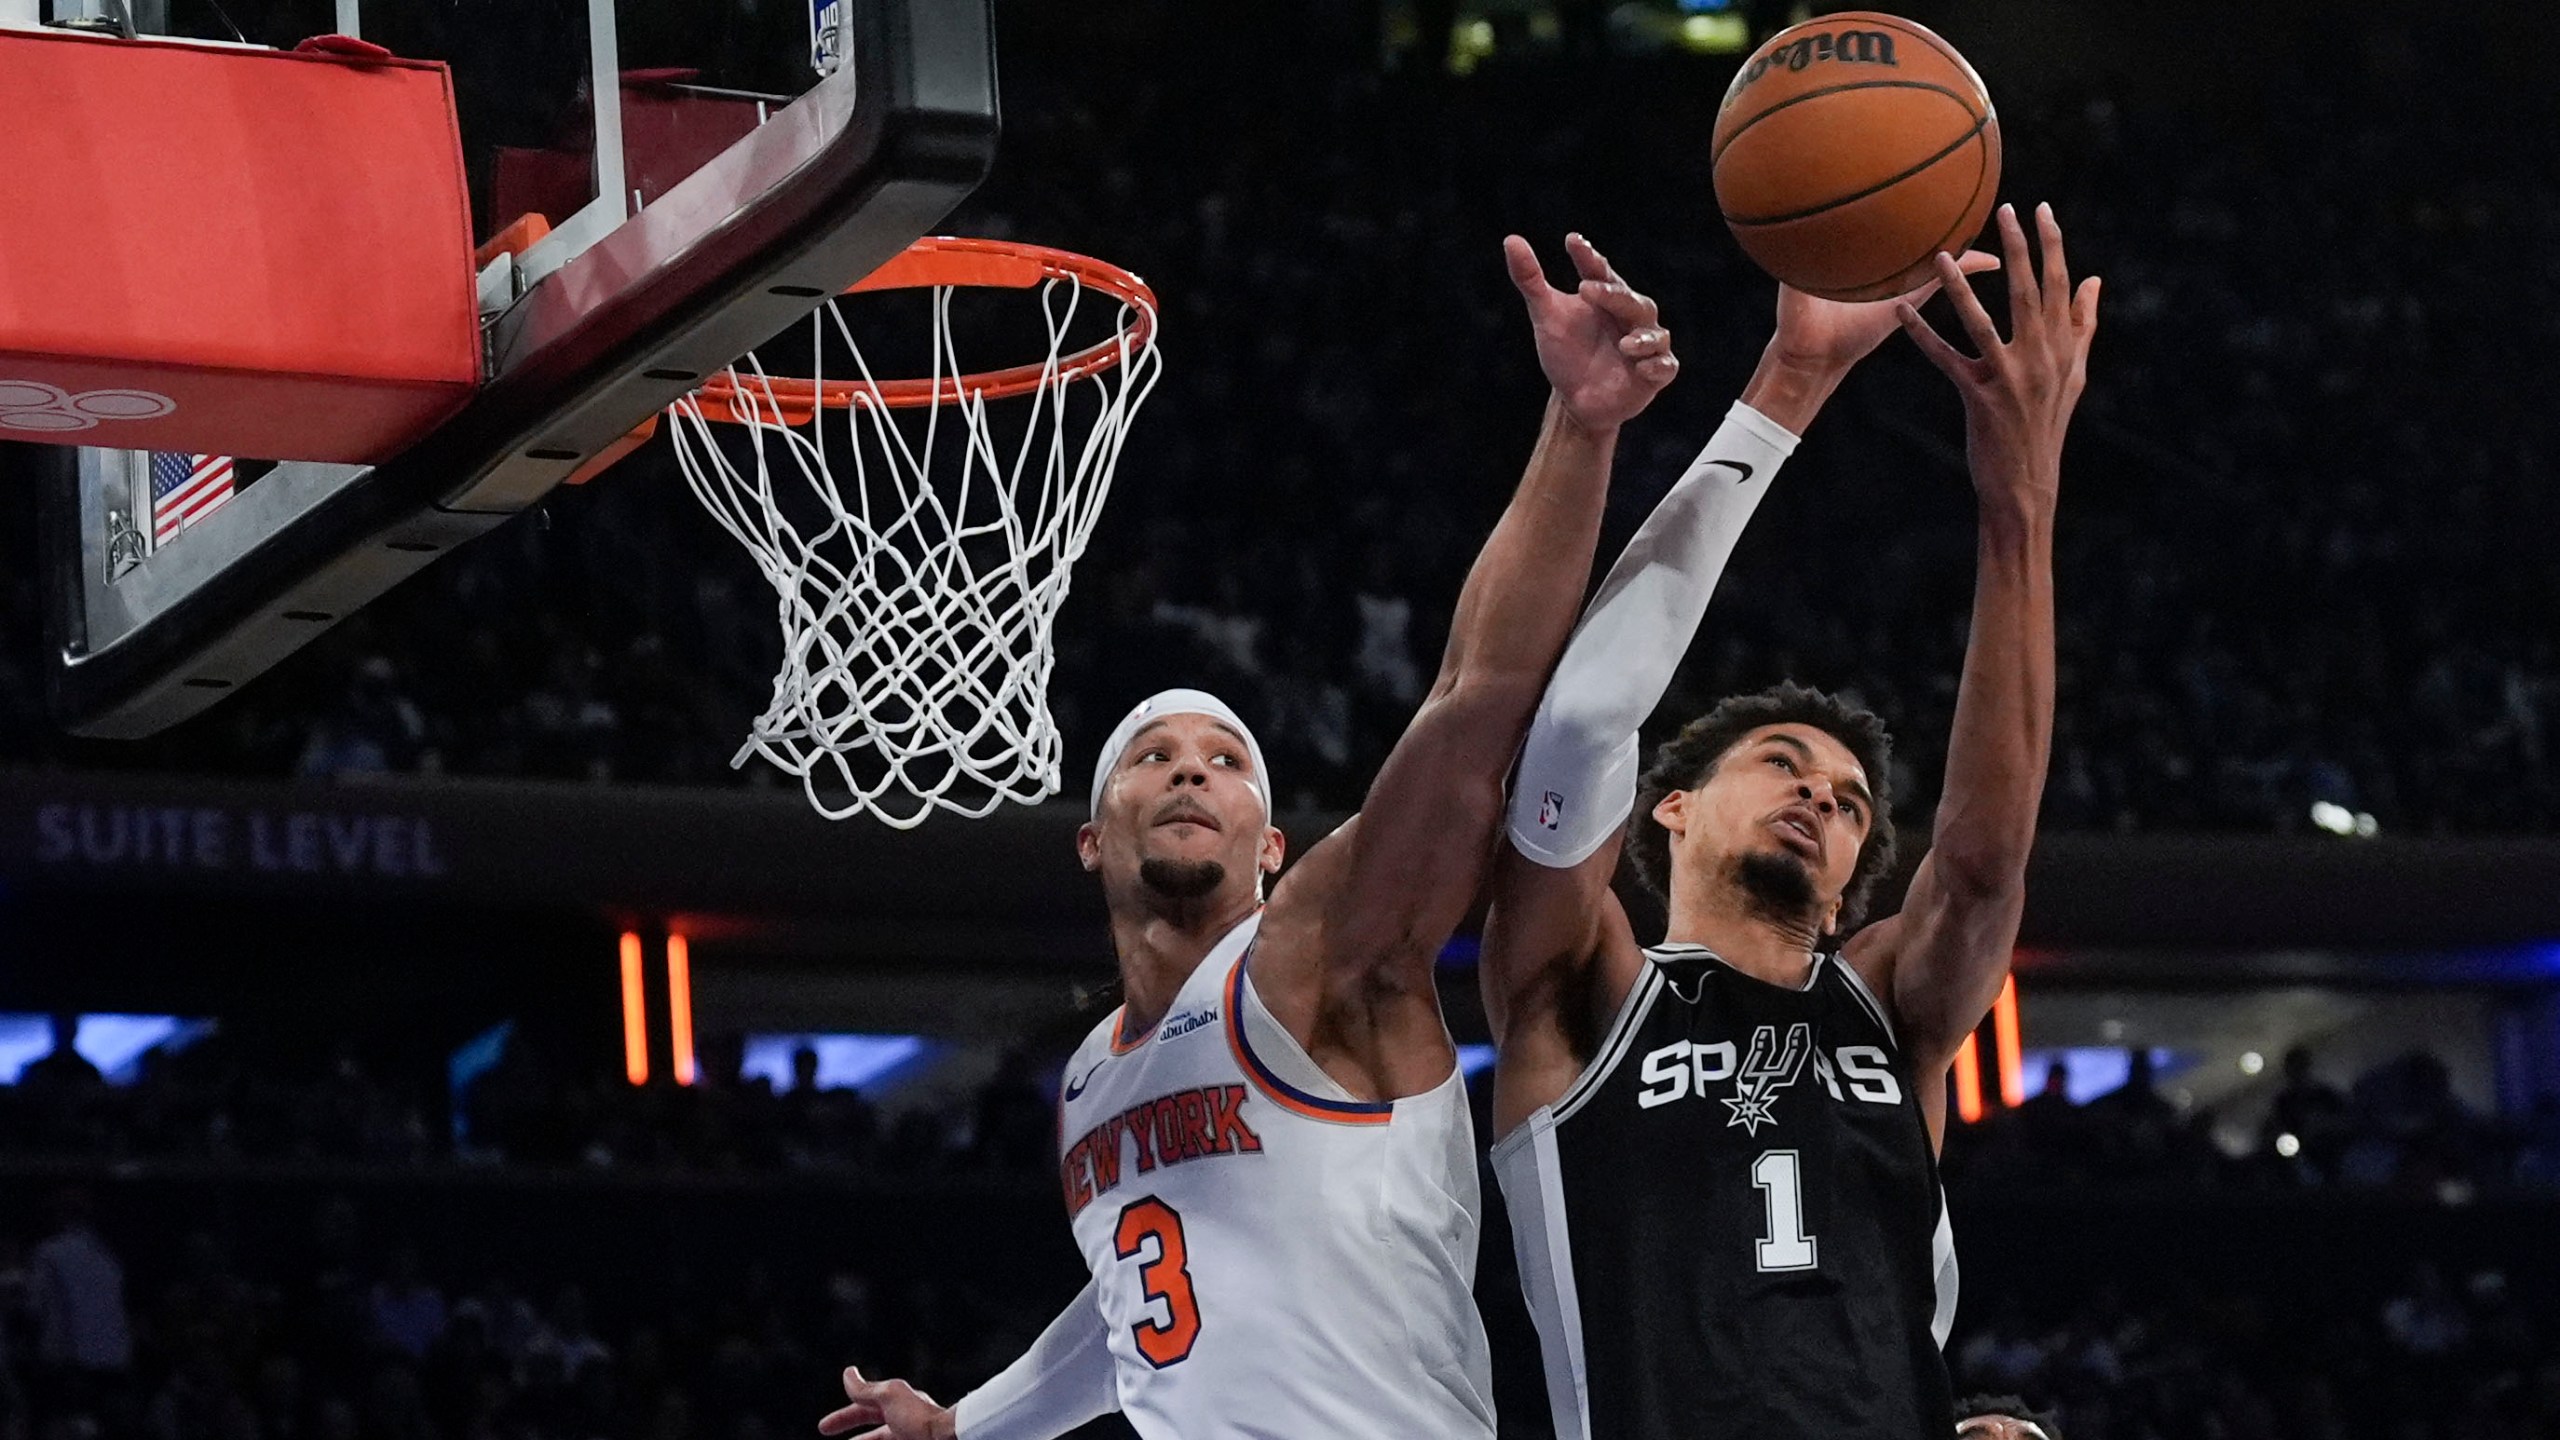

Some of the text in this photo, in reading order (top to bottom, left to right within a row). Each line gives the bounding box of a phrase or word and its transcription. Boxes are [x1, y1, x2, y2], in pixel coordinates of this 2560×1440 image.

[35, 803, 444, 875] SUITE LEVEL
[1160, 1026, 1182, 1041] abu
[1183, 1006, 1218, 1033] dhabi
[1124, 1083, 1265, 1177] YORK
[1638, 1023, 1902, 1137] SPURS
[1751, 1149, 1818, 1272] 1
[1114, 1194, 1201, 1370] 3
